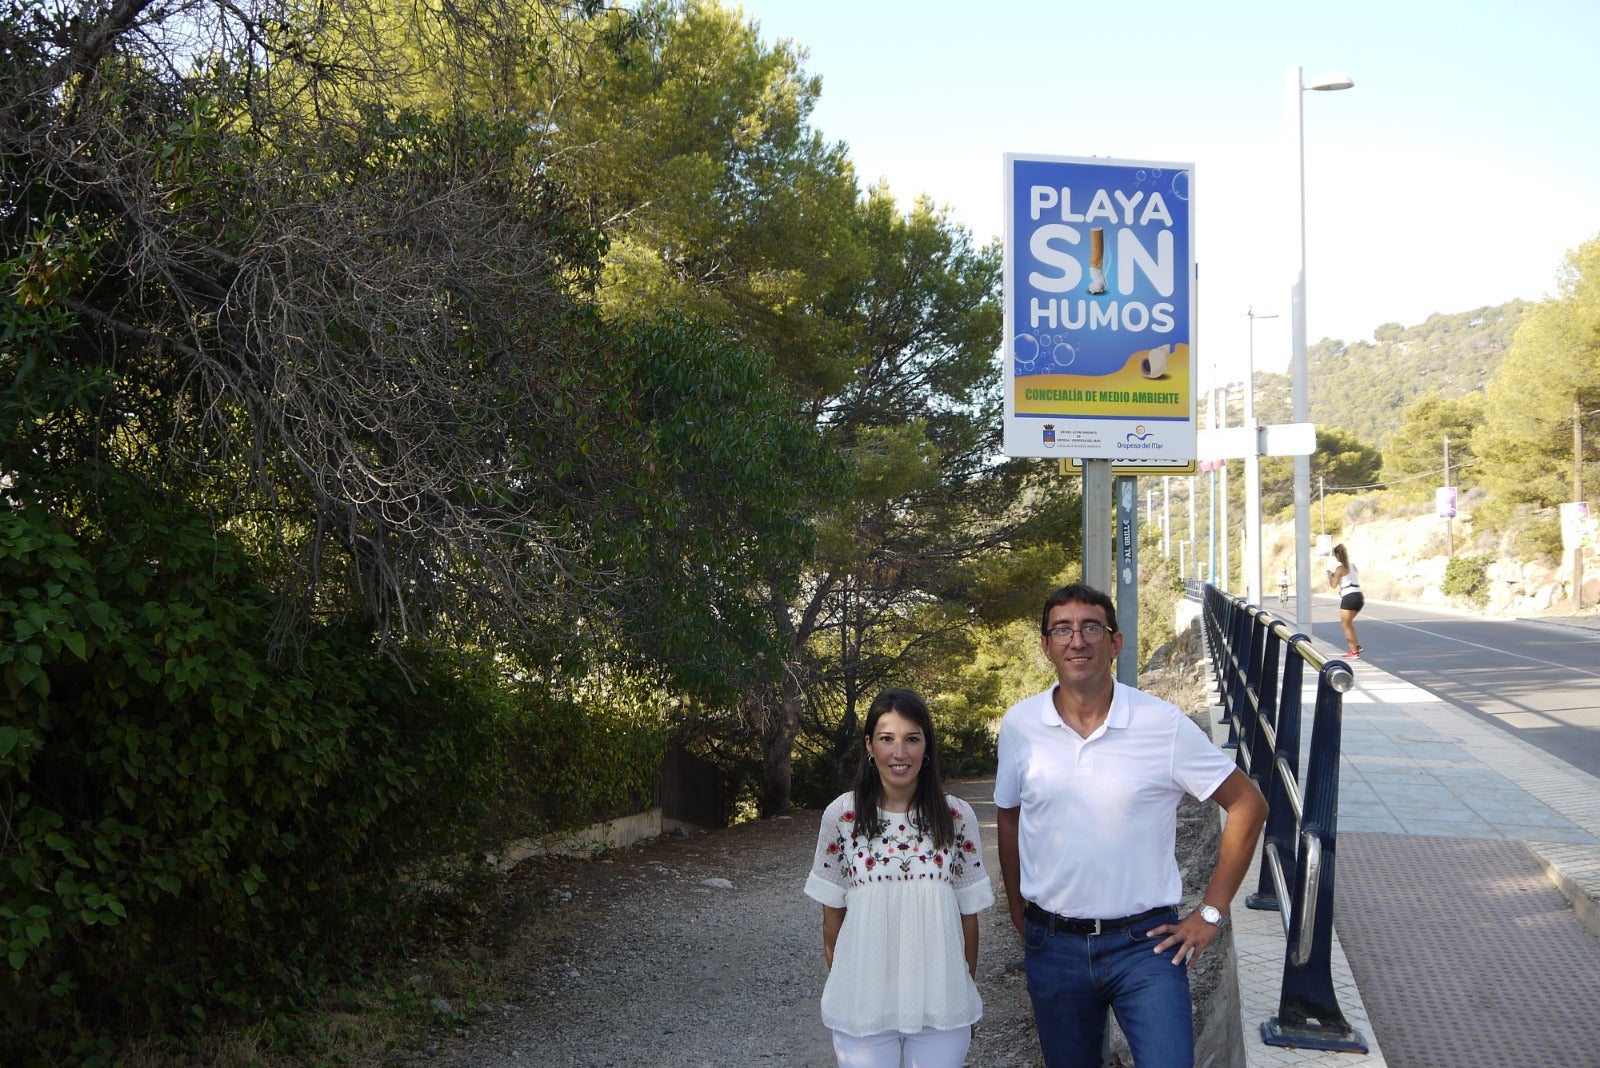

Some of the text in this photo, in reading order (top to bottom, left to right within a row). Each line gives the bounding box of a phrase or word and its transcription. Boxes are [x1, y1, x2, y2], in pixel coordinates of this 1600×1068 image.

[1030, 185, 1174, 227] PLAYA
[1028, 223, 1174, 298] SIN
[1030, 297, 1175, 333] HUMOS
[1025, 388, 1180, 404] CONCEJALÍA DE MEDIO AMBIENTE
[1117, 441, 1141, 450] Oropesa
[1123, 524, 1131, 546] GRILL
